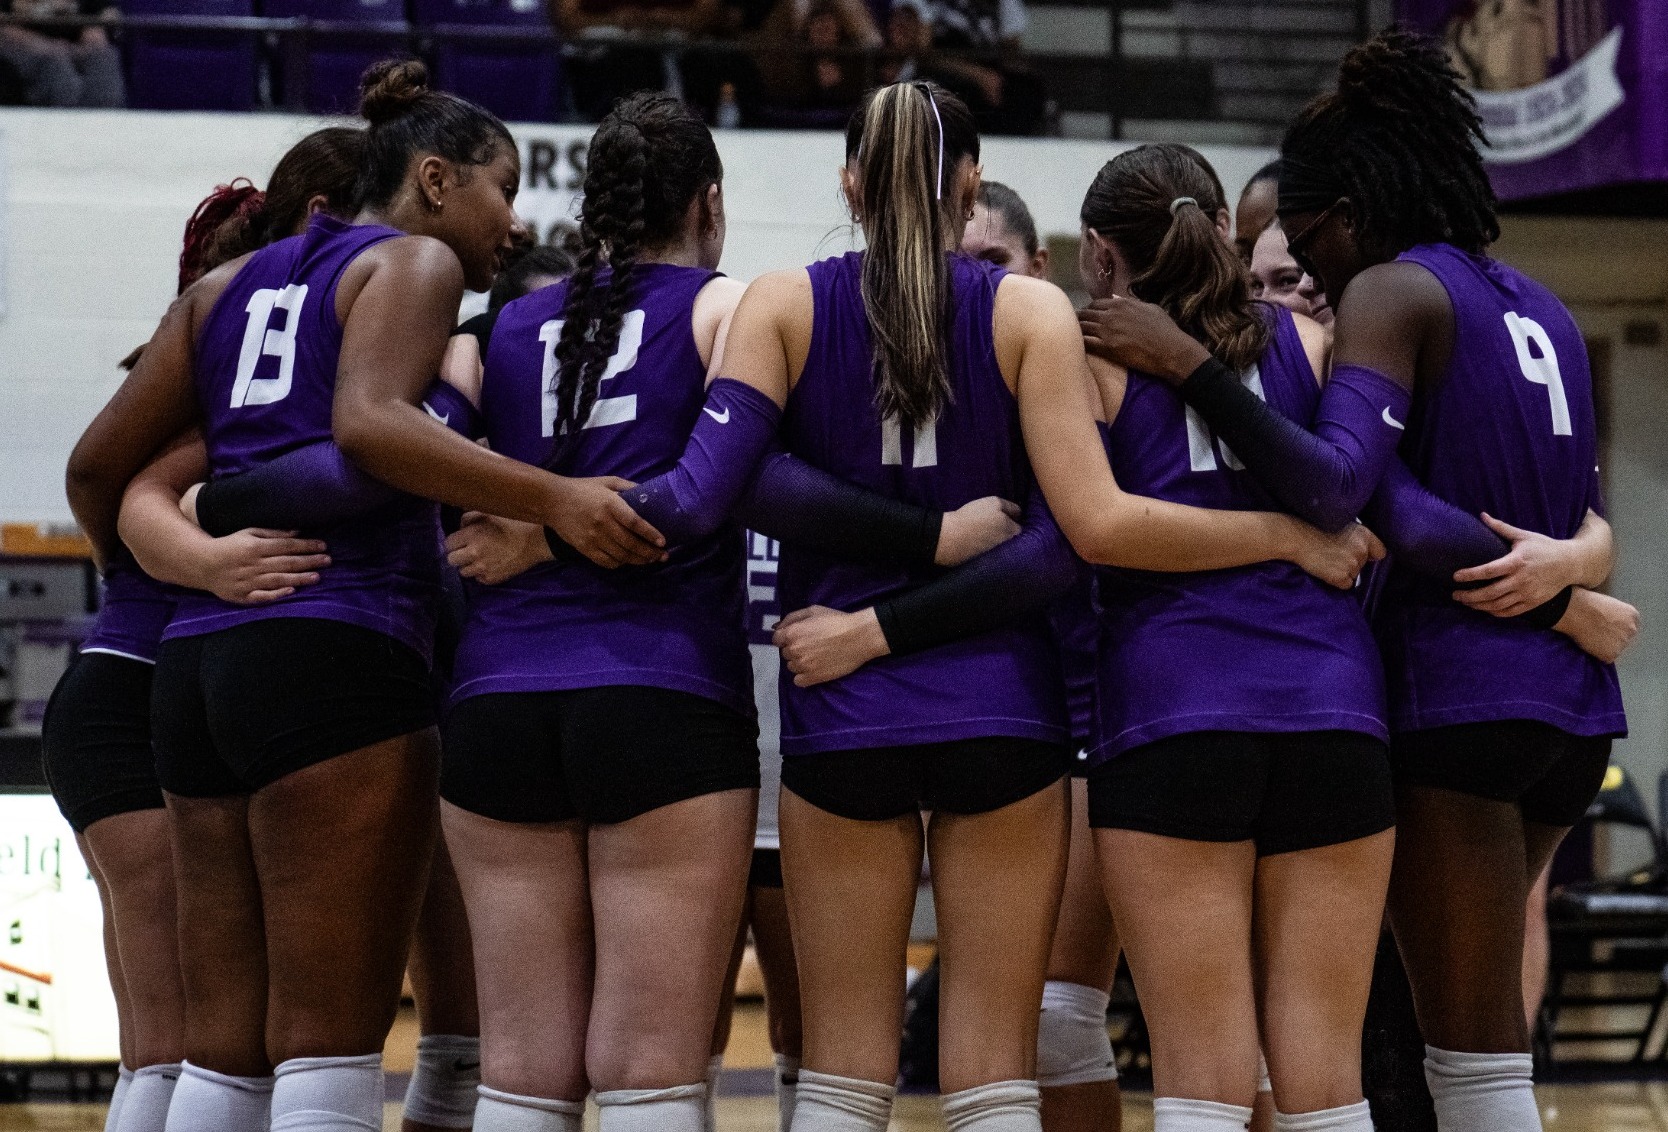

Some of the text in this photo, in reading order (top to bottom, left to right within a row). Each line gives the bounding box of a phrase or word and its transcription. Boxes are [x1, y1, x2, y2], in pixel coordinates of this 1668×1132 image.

[230, 284, 308, 409] 13
[538, 309, 645, 438] 12
[1503, 310, 1573, 436] 9
